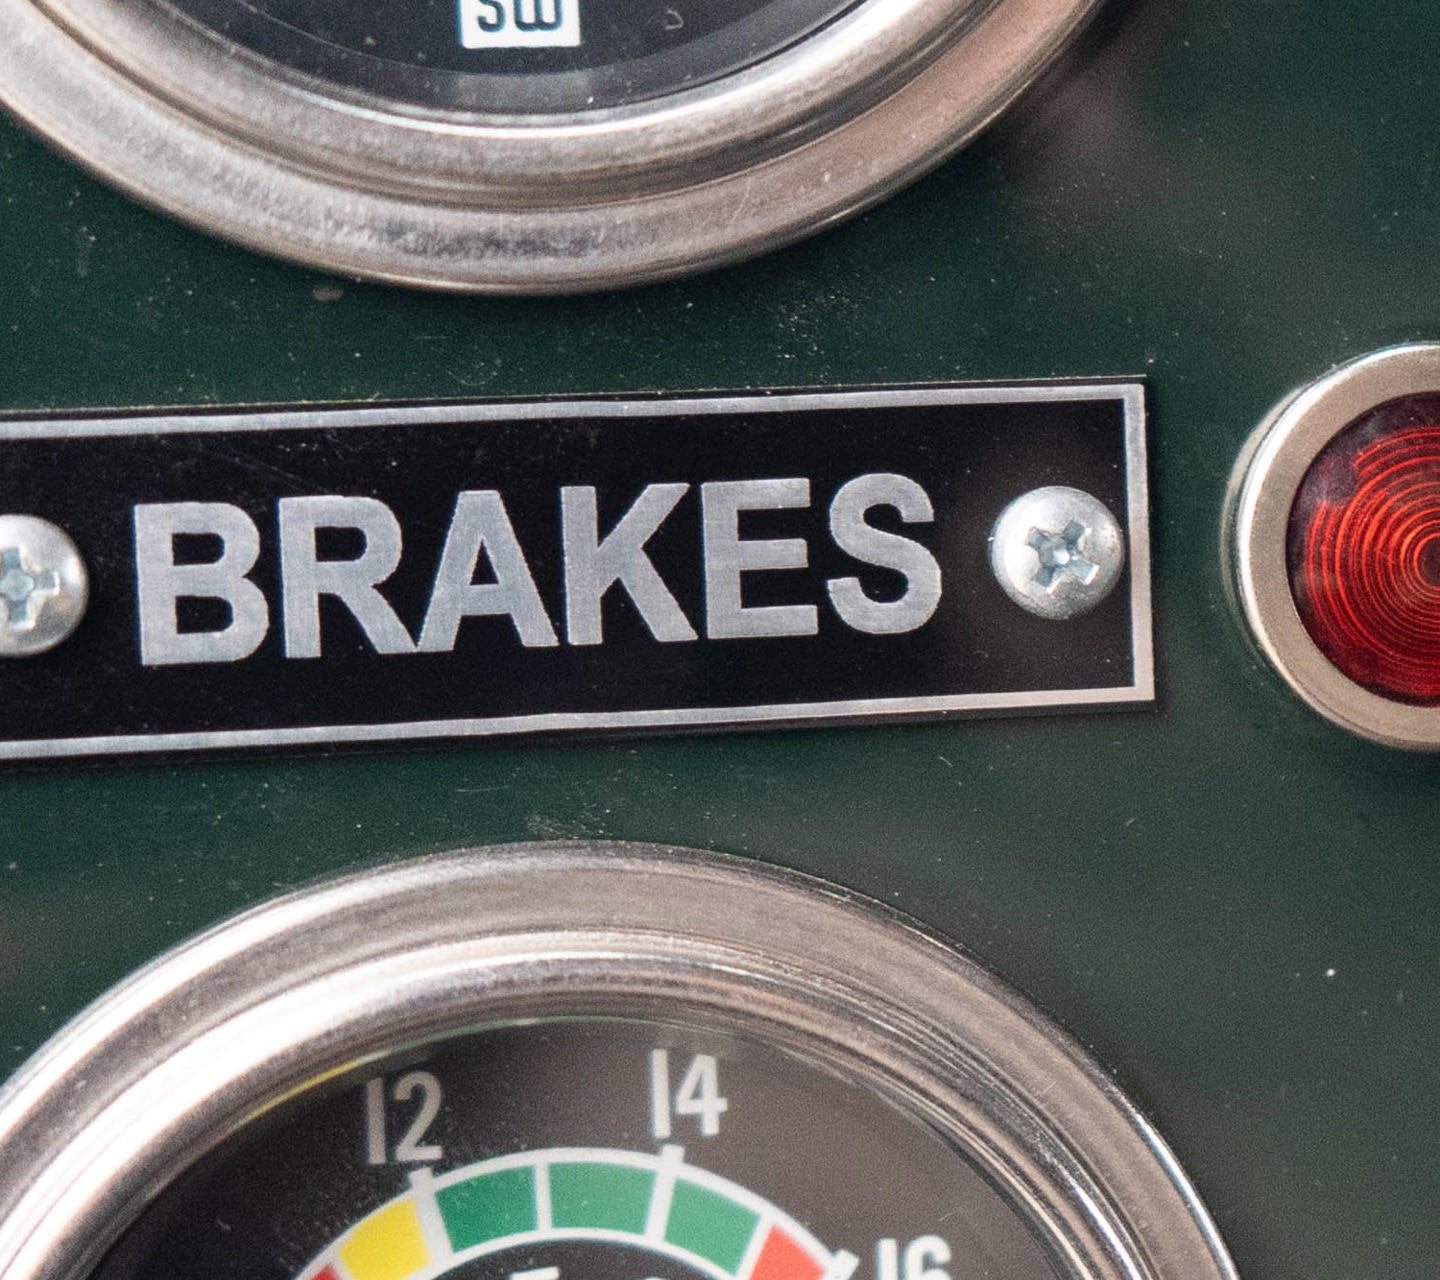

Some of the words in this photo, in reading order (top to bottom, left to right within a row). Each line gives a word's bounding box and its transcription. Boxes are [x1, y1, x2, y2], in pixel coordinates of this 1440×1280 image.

[133, 472, 942, 666] BRAKES
[365, 1071, 443, 1165] 12
[649, 1048, 728, 1138] 14
